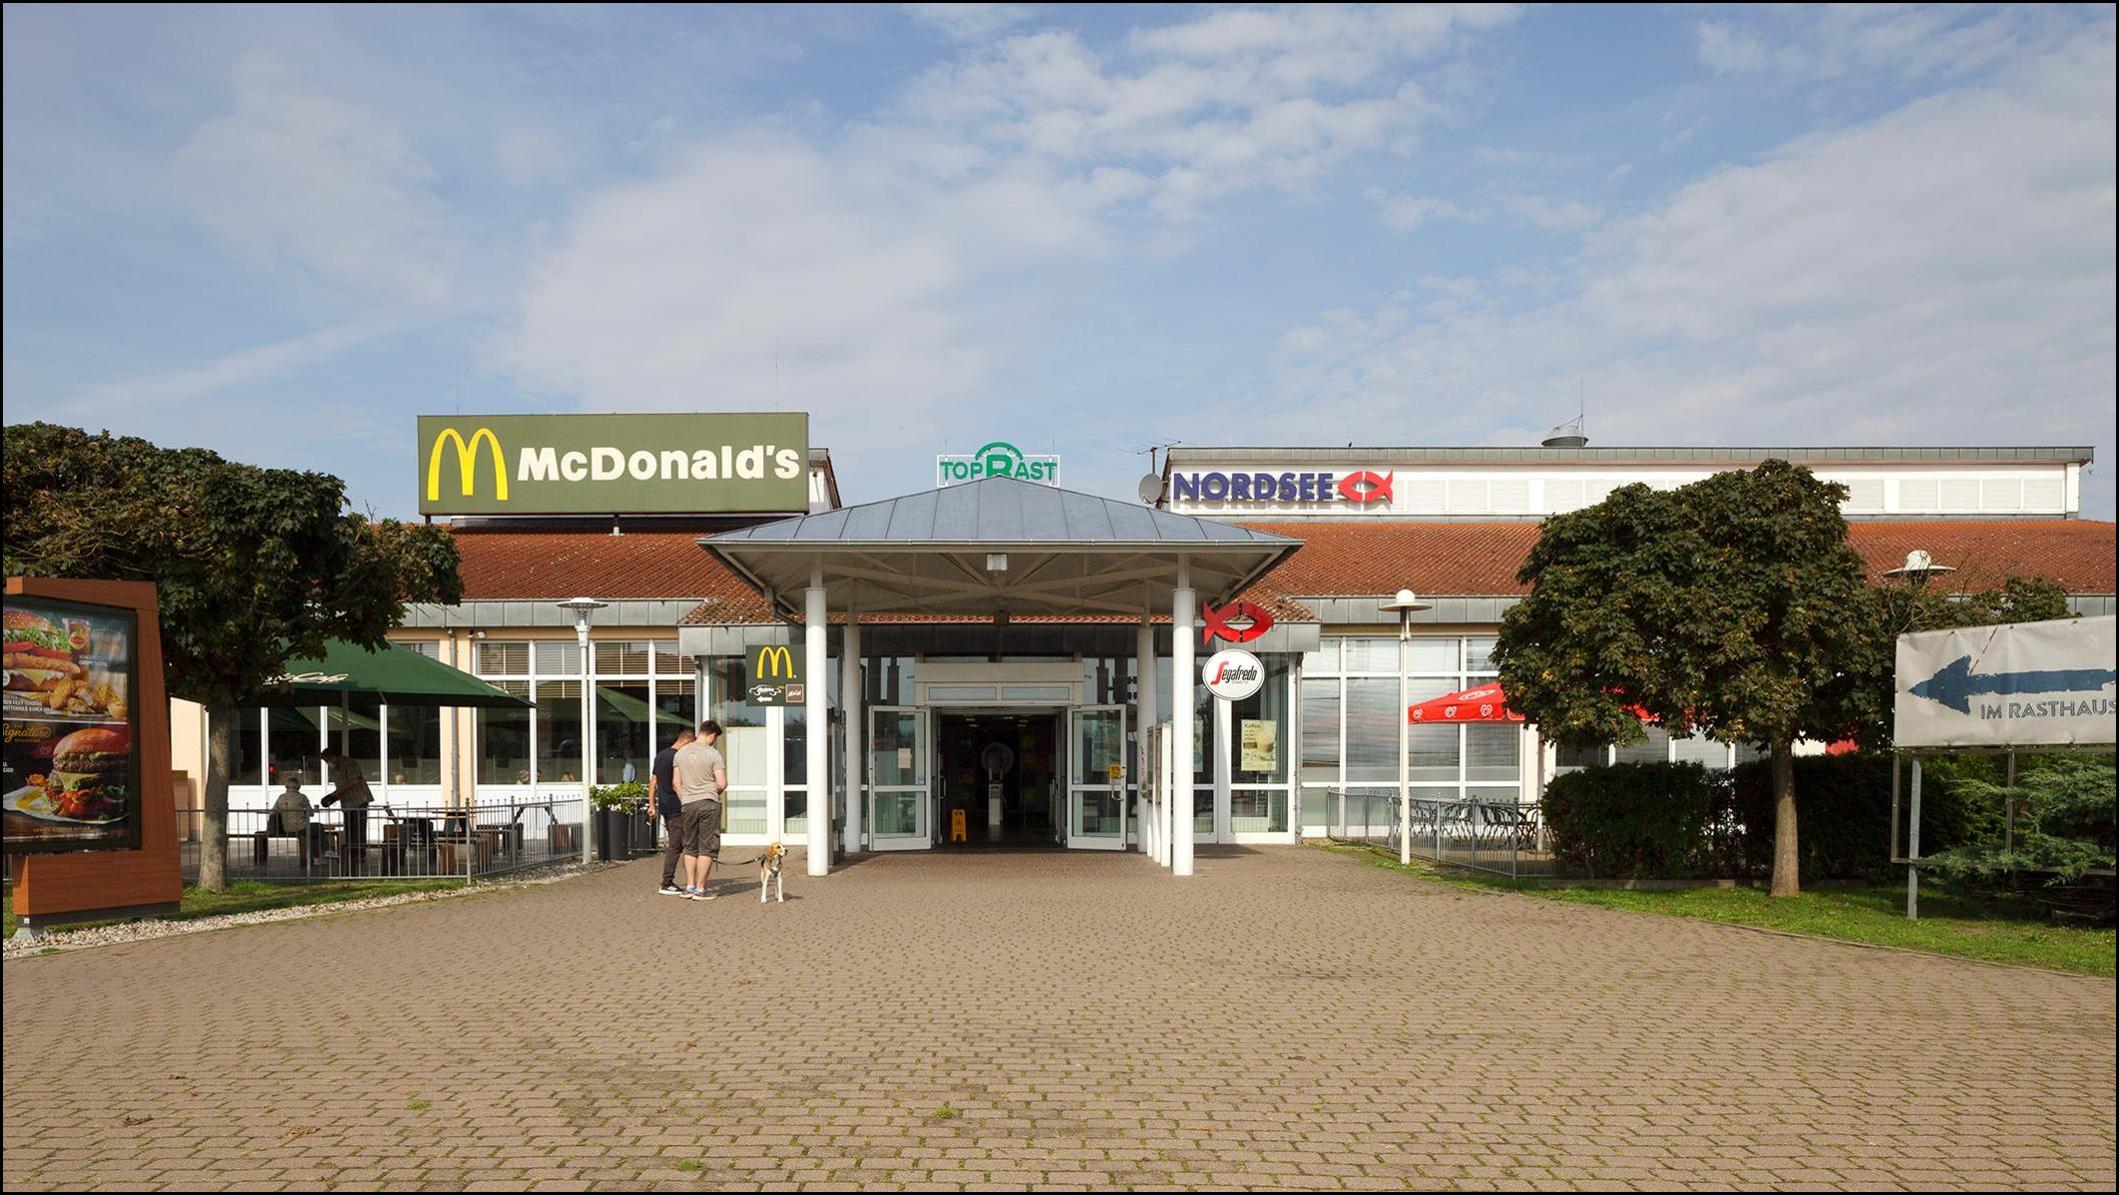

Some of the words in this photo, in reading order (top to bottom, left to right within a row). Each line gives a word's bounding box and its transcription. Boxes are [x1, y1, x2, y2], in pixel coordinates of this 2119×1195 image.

[517, 445, 800, 481] McDonald's
[1173, 472, 1334, 500] NORDSEE
[1211, 661, 1258, 686] Segafredo
[1980, 704, 2003, 719] IM
